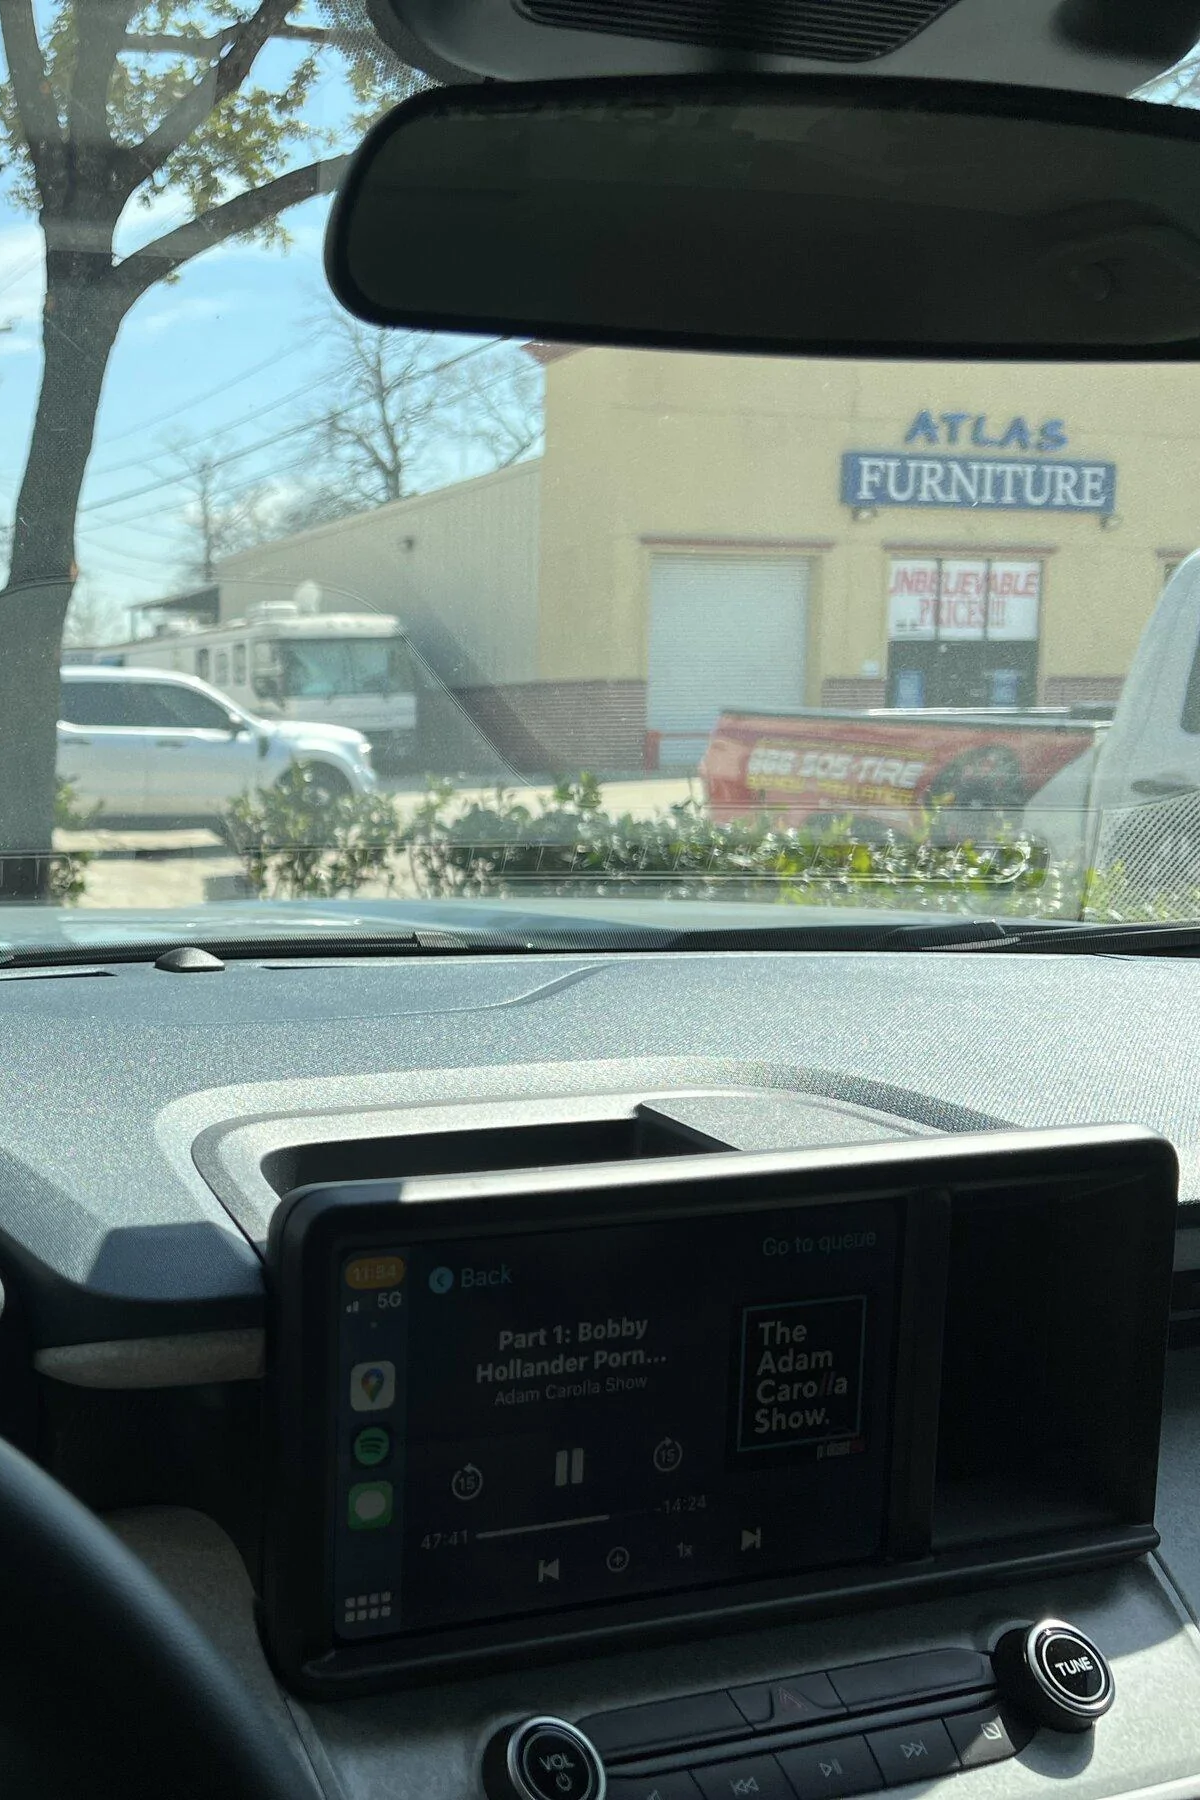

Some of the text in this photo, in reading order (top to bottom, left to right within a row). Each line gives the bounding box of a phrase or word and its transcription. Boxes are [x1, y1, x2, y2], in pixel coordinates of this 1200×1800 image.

[904, 409, 1069, 451] ATLAS
[858, 457, 1107, 506] FURNITURE
[761, 1231, 877, 1257] Go to queue
[460, 1263, 513, 1288] Back
[377, 1290, 402, 1309] 5G
[498, 1315, 649, 1351] Part 1: Bobby
[758, 1320, 808, 1346] The
[476, 1353, 587, 1384] Hollander
[756, 1348, 833, 1376] Adam
[494, 1375, 649, 1407] Adam Carolla Show
[753, 1407, 830, 1435] Show.
[1054, 1656, 1094, 1677] TUNE
[539, 1753, 575, 1771] VOL
